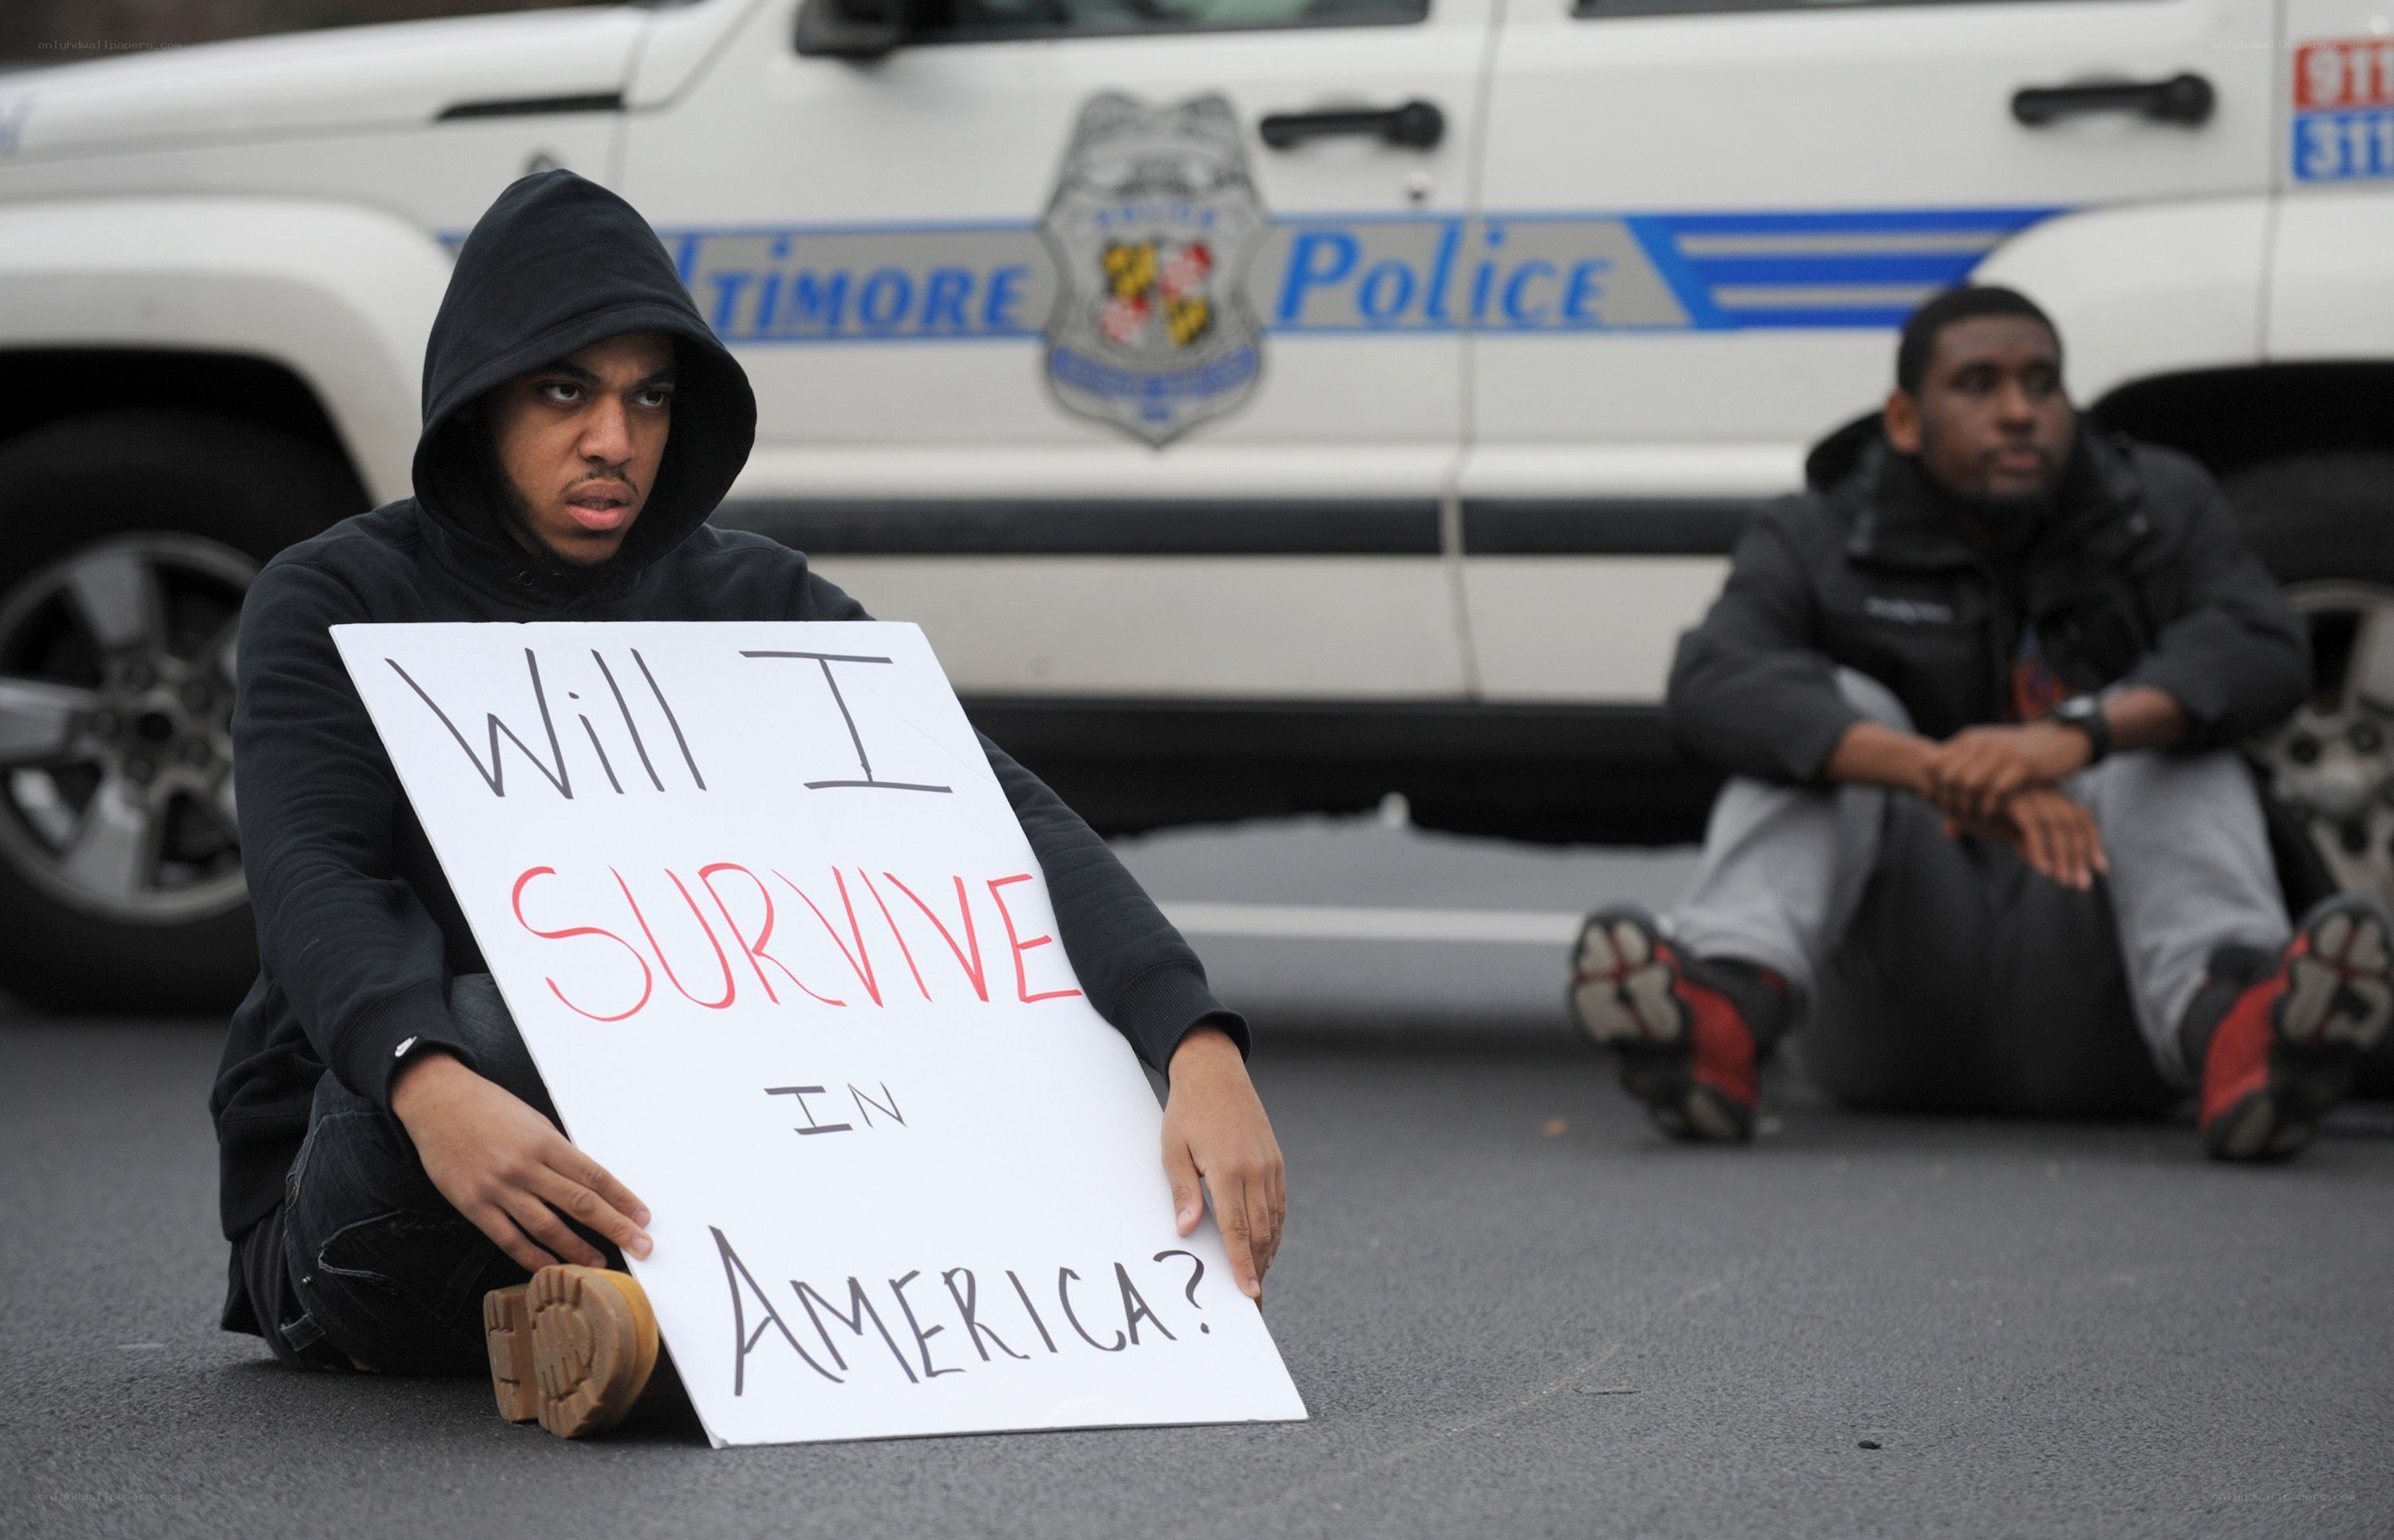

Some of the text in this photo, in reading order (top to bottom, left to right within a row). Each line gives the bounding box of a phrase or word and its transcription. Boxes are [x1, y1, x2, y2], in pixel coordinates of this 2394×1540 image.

[2306, 48, 2394, 103] 911
[2306, 120, 2394, 172] 311
[385, 648, 953, 800] Will I
[511, 863, 1083, 1022] SURVIVE
[763, 1080, 907, 1135] IN
[709, 1225, 1211, 1396] AMERICA?
